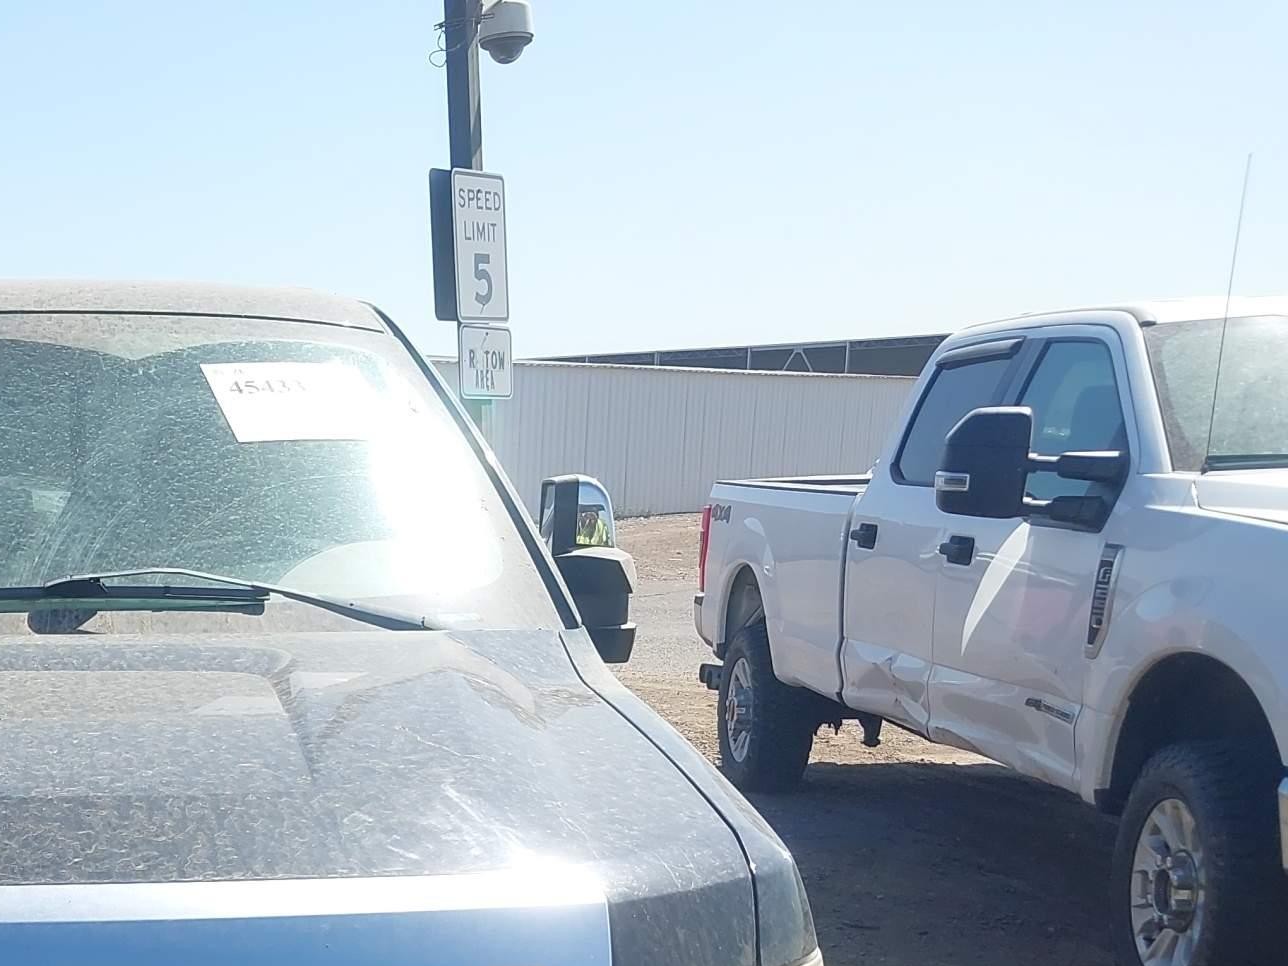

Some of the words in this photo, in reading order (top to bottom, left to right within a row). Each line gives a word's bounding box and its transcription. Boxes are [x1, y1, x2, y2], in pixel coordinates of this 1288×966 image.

[458, 188, 501, 211] SPEED
[464, 220, 497, 243] LIMIT
[474, 253, 493, 305] 5
[475, 369, 496, 391] AREA
